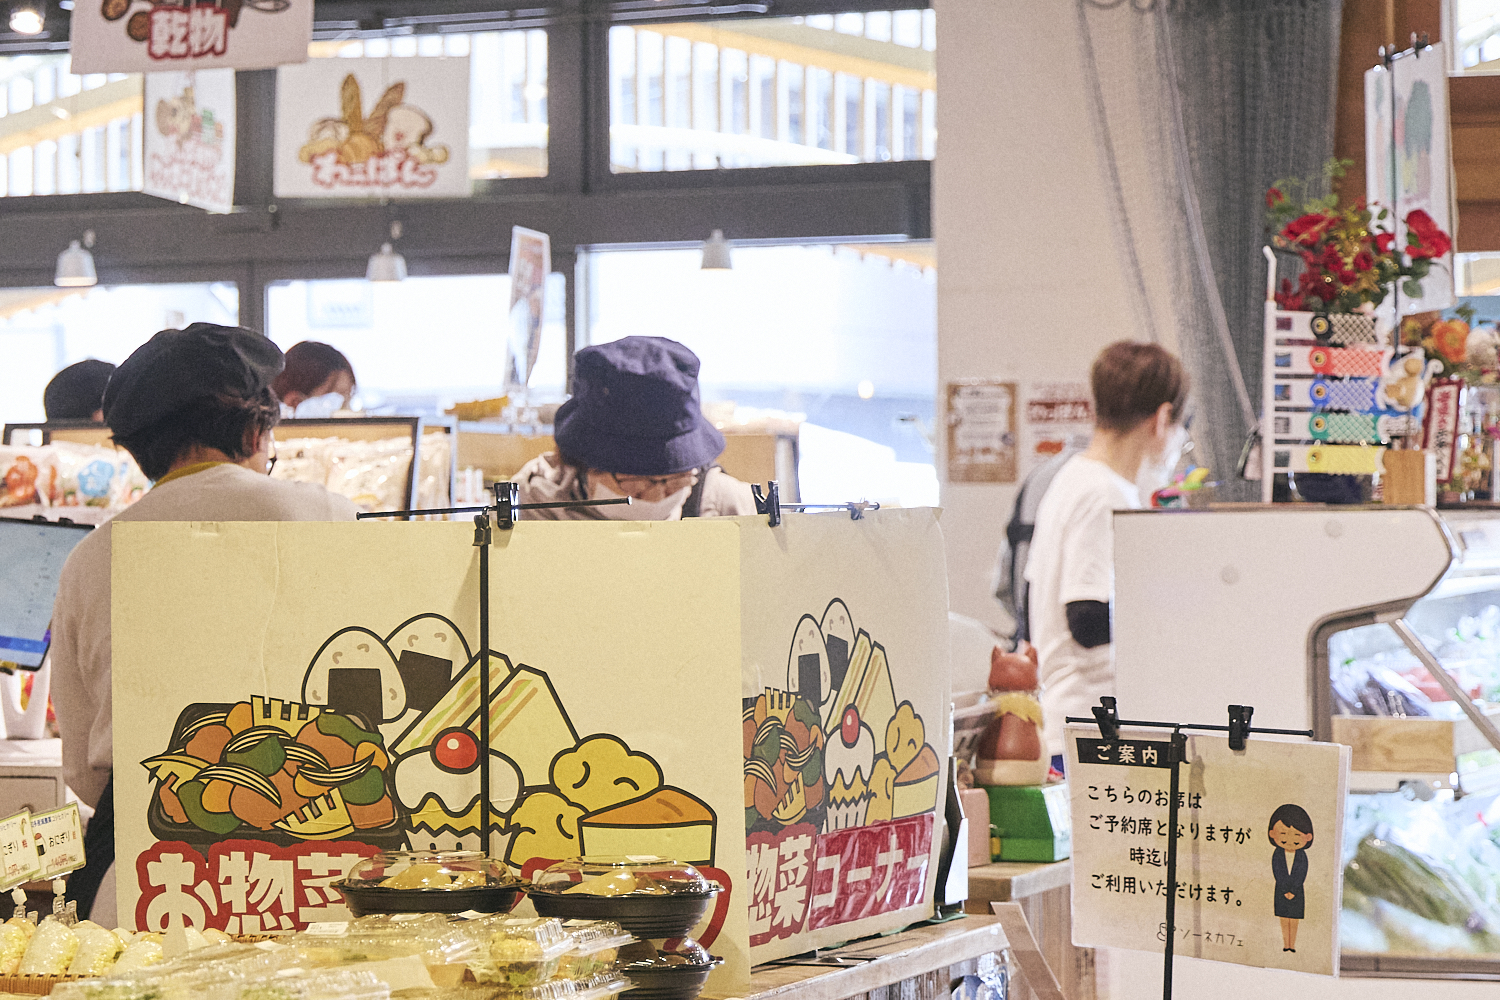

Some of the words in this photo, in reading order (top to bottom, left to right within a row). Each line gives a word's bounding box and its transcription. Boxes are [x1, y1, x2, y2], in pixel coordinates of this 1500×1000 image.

[150, 6, 228, 57] 乾物
[1096, 744, 1158, 765] ご案内
[1089, 814, 1252, 845] ご予約席となりますが
[1091, 873, 1242, 907] ご利用いただけます。
[1181, 929, 1244, 947] ソーネカフェ
